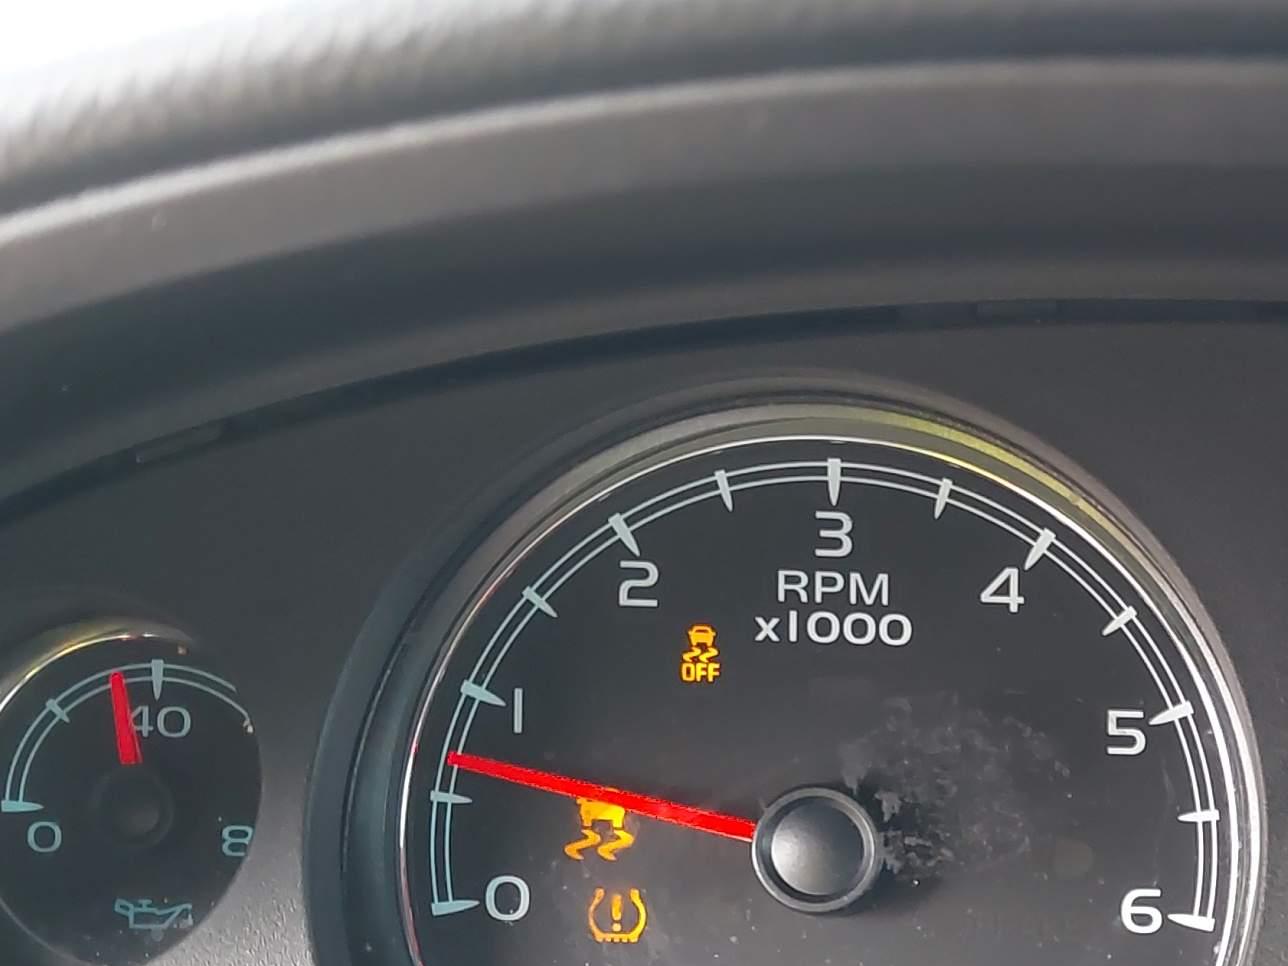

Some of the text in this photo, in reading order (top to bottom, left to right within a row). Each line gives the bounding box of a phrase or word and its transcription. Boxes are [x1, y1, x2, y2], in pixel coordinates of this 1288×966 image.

[814, 512, 853, 557] 3
[619, 561, 659, 607] 2
[777, 570, 889, 606] RPM
[980, 568, 1024, 613] 4
[754, 611, 912, 646] x1000
[681, 662, 721, 682] OFF
[130, 704, 191, 739] 40
[513, 688, 523, 734] 1
[1106, 710, 1146, 755] 5
[27, 821, 62, 853] 0
[485, 875, 529, 920] 0
[1120, 888, 1162, 934] 6
